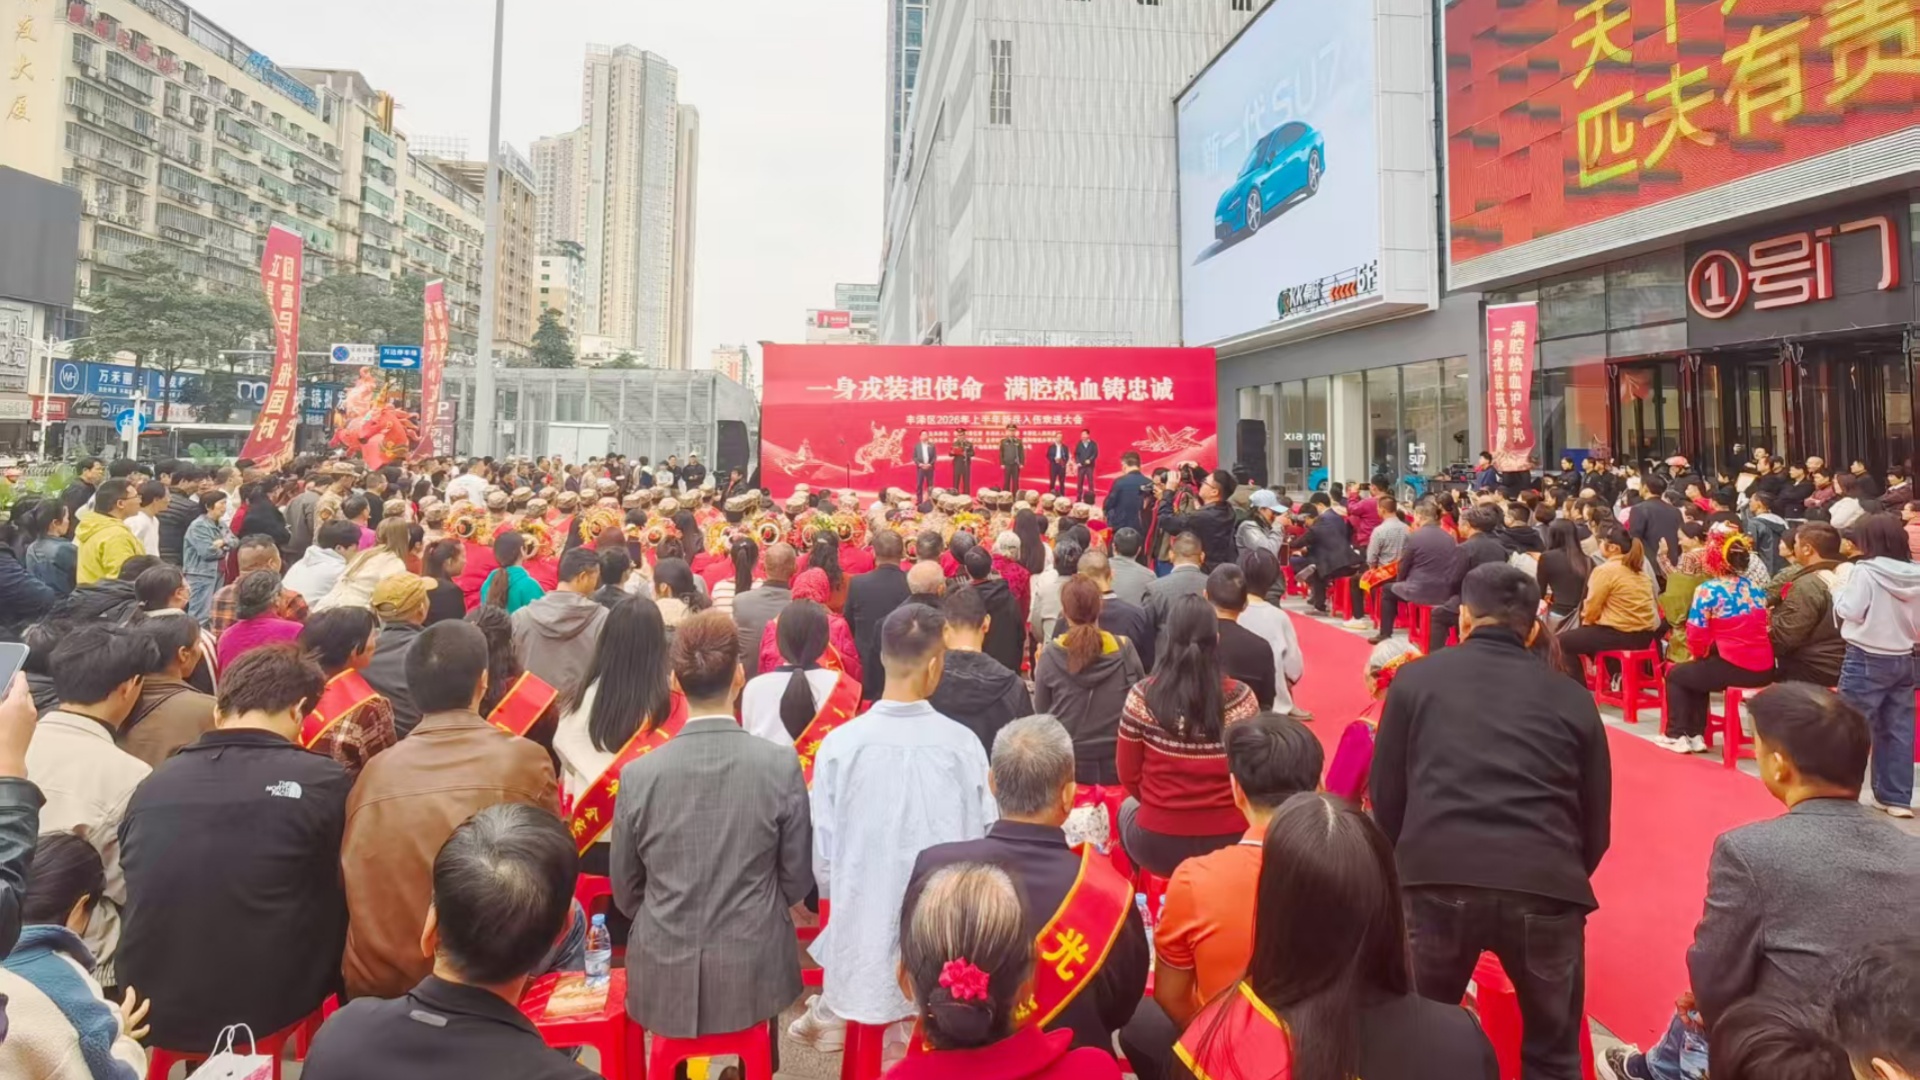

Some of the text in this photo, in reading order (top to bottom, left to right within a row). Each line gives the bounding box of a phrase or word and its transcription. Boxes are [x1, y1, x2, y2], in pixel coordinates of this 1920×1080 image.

[1577, 0, 1920, 188] 匹夫有责
[805, 375, 1174, 402] 一身戎装担使命 满腔热血铸忠诚
[1507, 320, 1527, 444] 满腔热血护家邦
[436, 401, 449, 415] P
[1408, 454, 1427, 465] SU7
